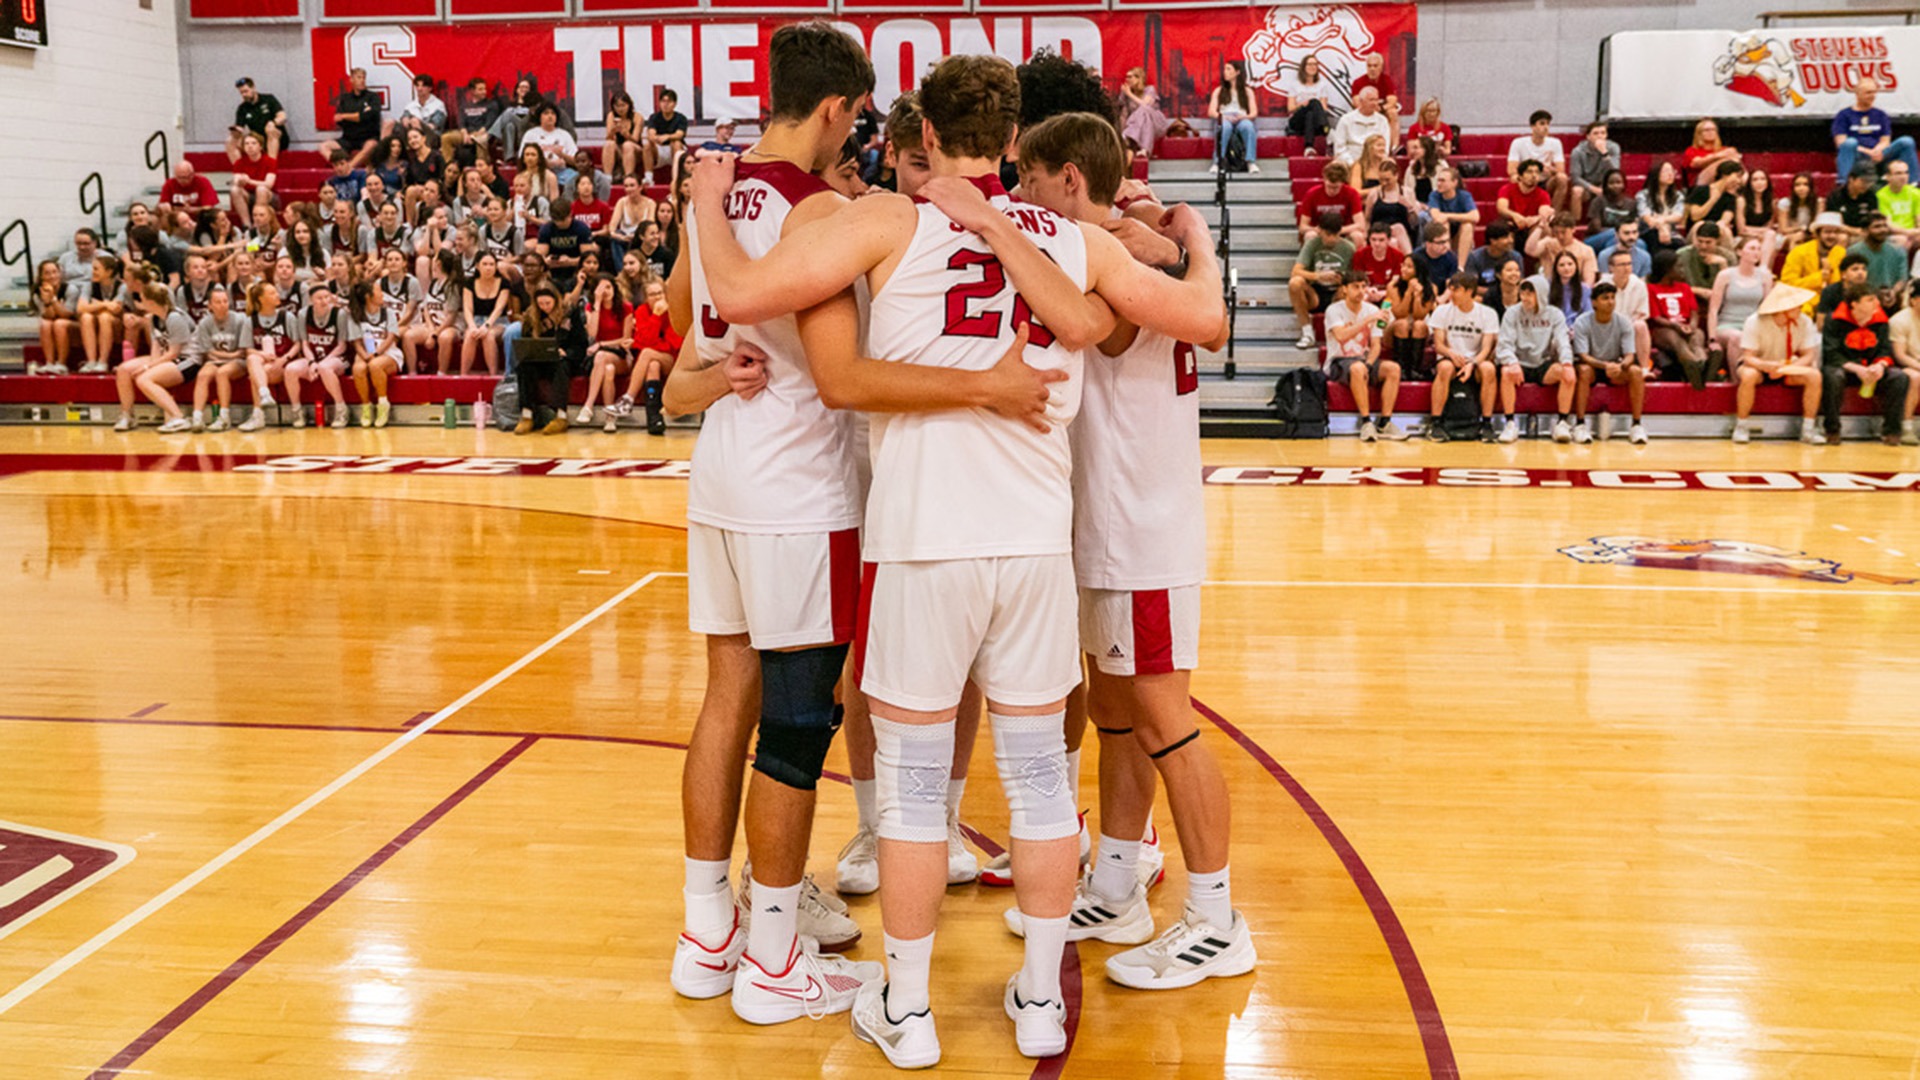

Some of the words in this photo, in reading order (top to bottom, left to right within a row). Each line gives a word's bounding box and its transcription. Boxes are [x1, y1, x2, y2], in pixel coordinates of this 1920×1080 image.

[344, 25, 417, 122] S
[553, 24, 759, 122] THE
[822, 17, 1102, 116] OND
[1791, 36, 1890, 61] STEVENS
[1797, 61, 1898, 93] DUCKS
